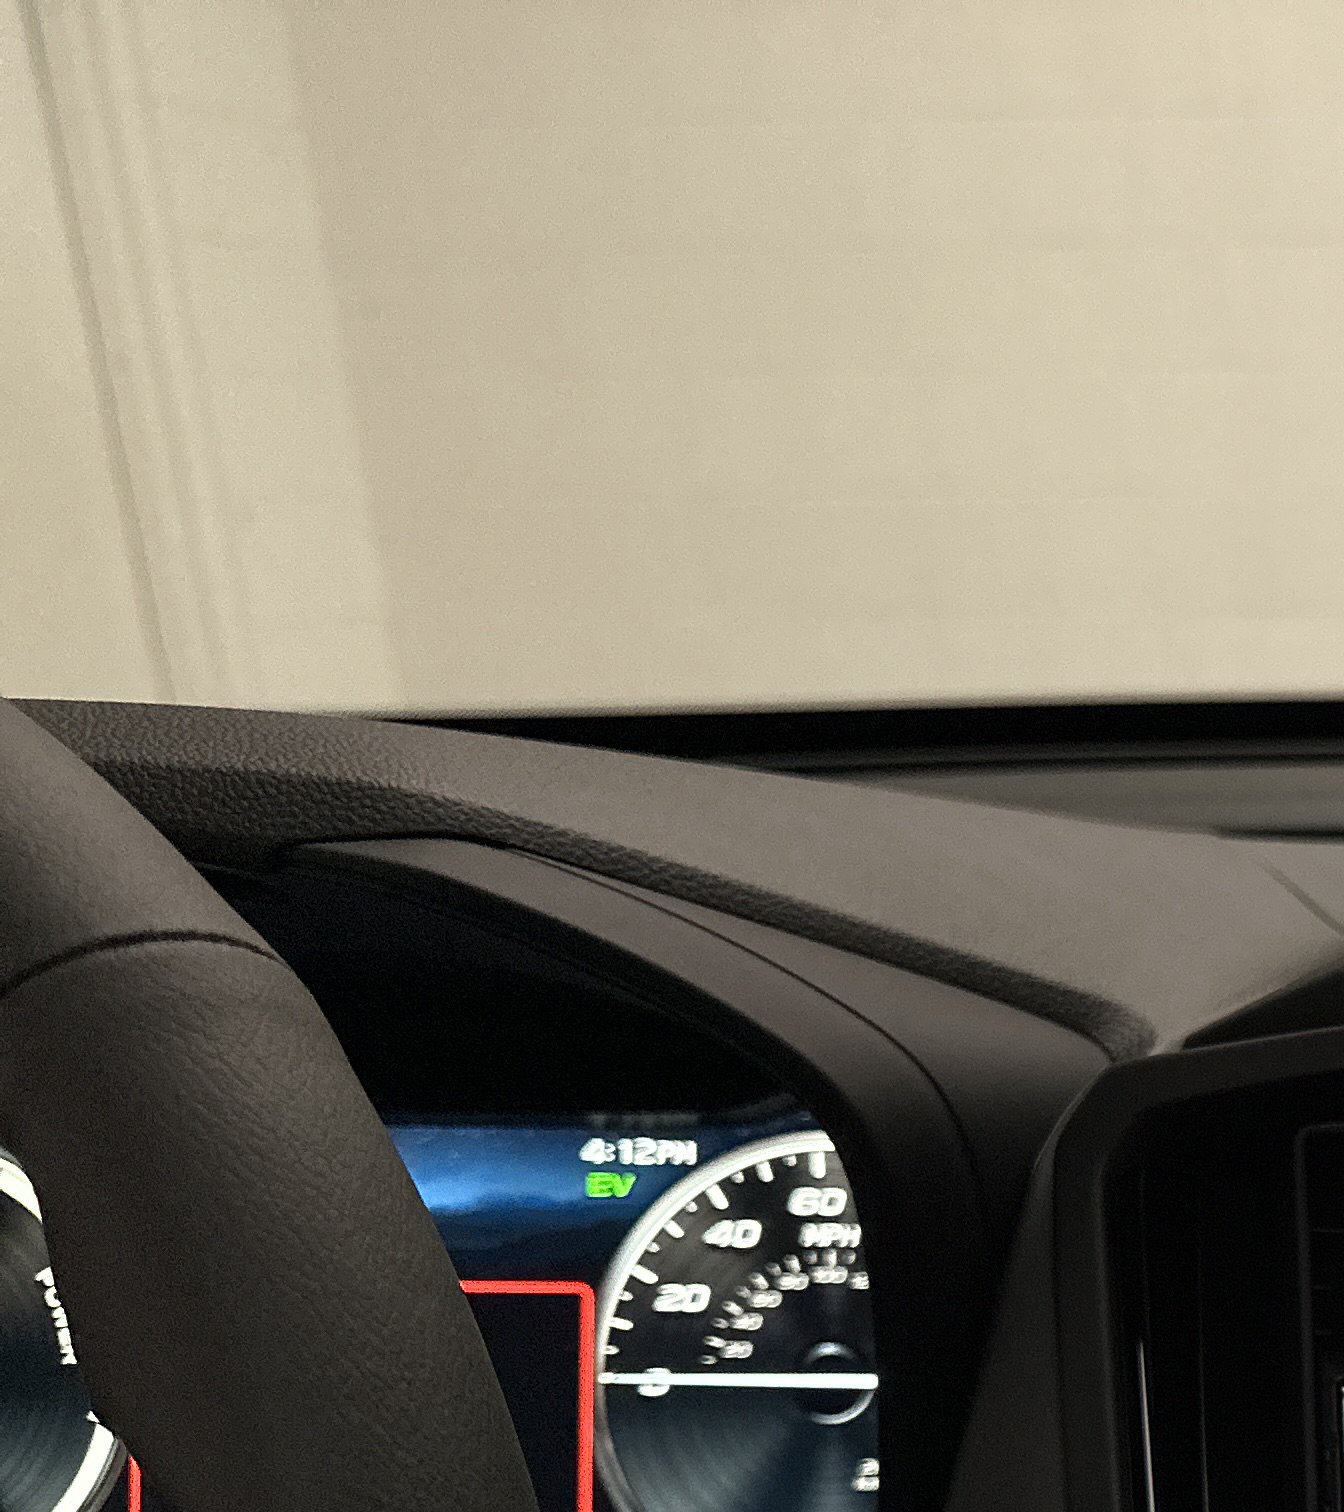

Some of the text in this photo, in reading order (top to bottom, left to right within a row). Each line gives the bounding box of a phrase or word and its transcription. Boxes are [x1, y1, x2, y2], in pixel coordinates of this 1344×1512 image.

[585, 1170, 638, 1198] EV
[787, 1186, 848, 1217] 60
[702, 1218, 763, 1249] 40
[652, 1283, 712, 1313] 20
